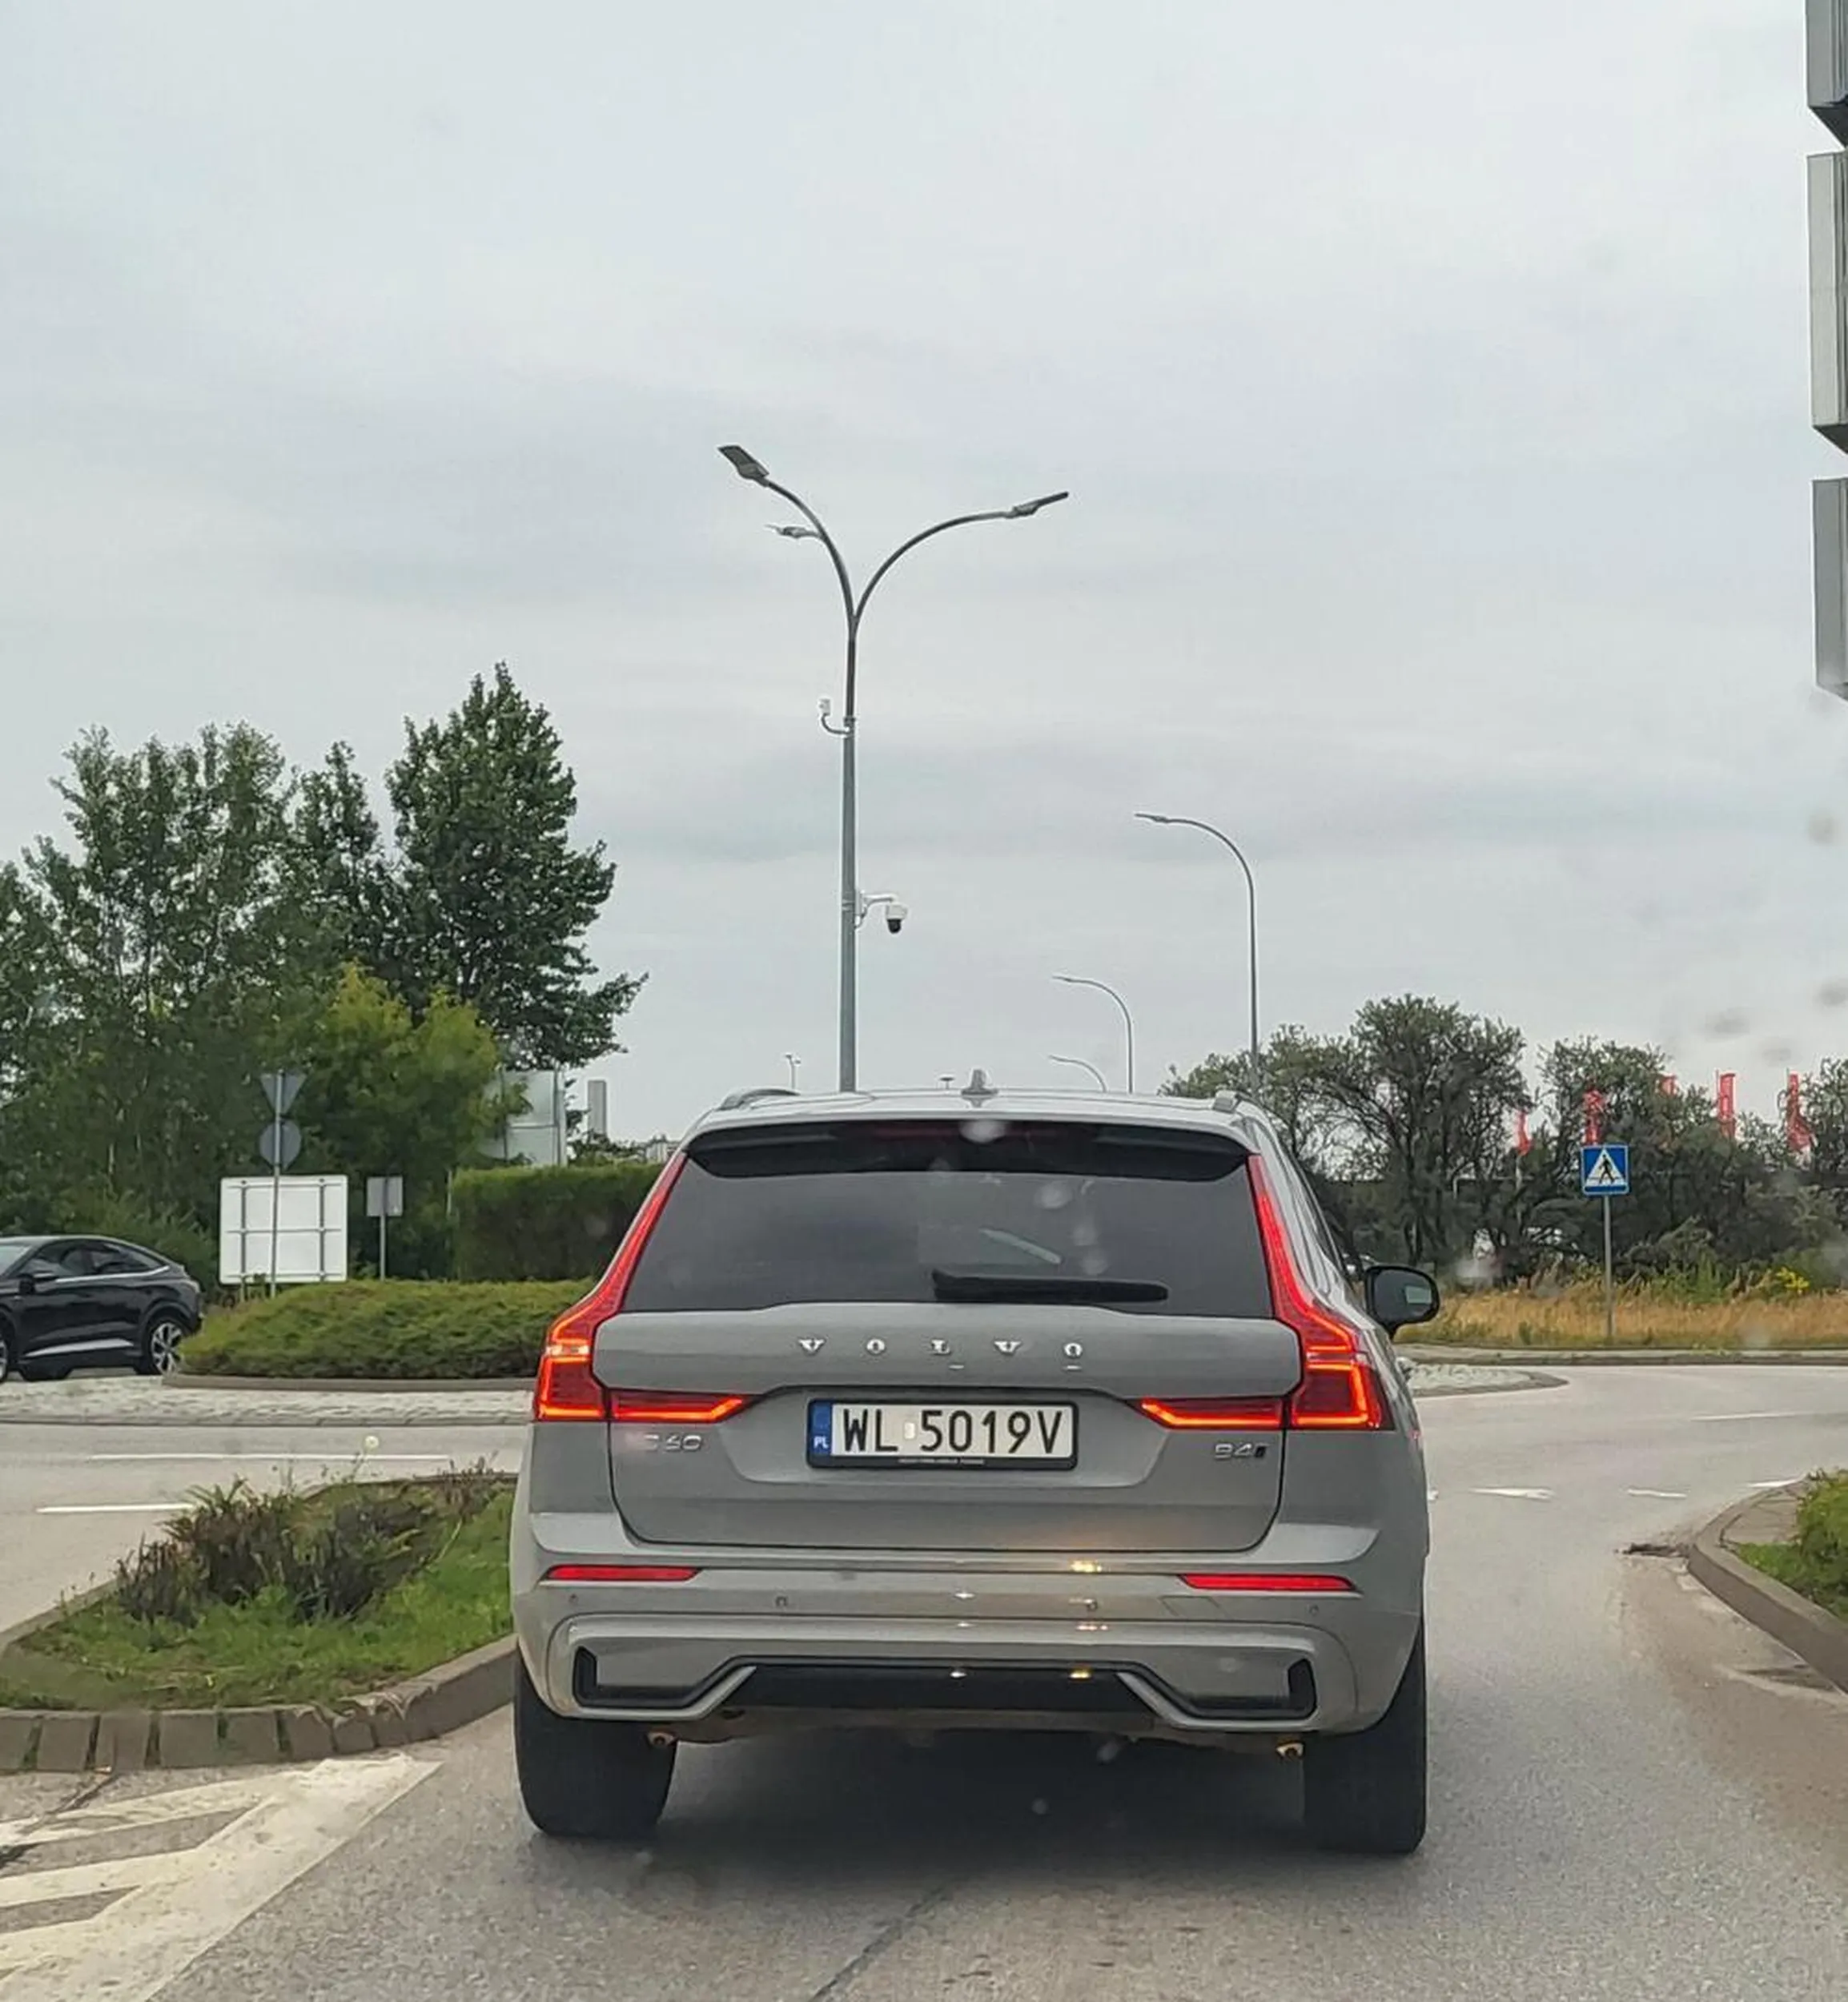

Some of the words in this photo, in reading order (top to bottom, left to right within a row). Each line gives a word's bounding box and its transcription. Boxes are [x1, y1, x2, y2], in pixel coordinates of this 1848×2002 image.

[798, 1338, 1083, 1358] VOLVO
[843, 1408, 899, 1453] WL
[920, 1409, 1063, 1454] 5019V
[814, 1437, 830, 1449] PL
